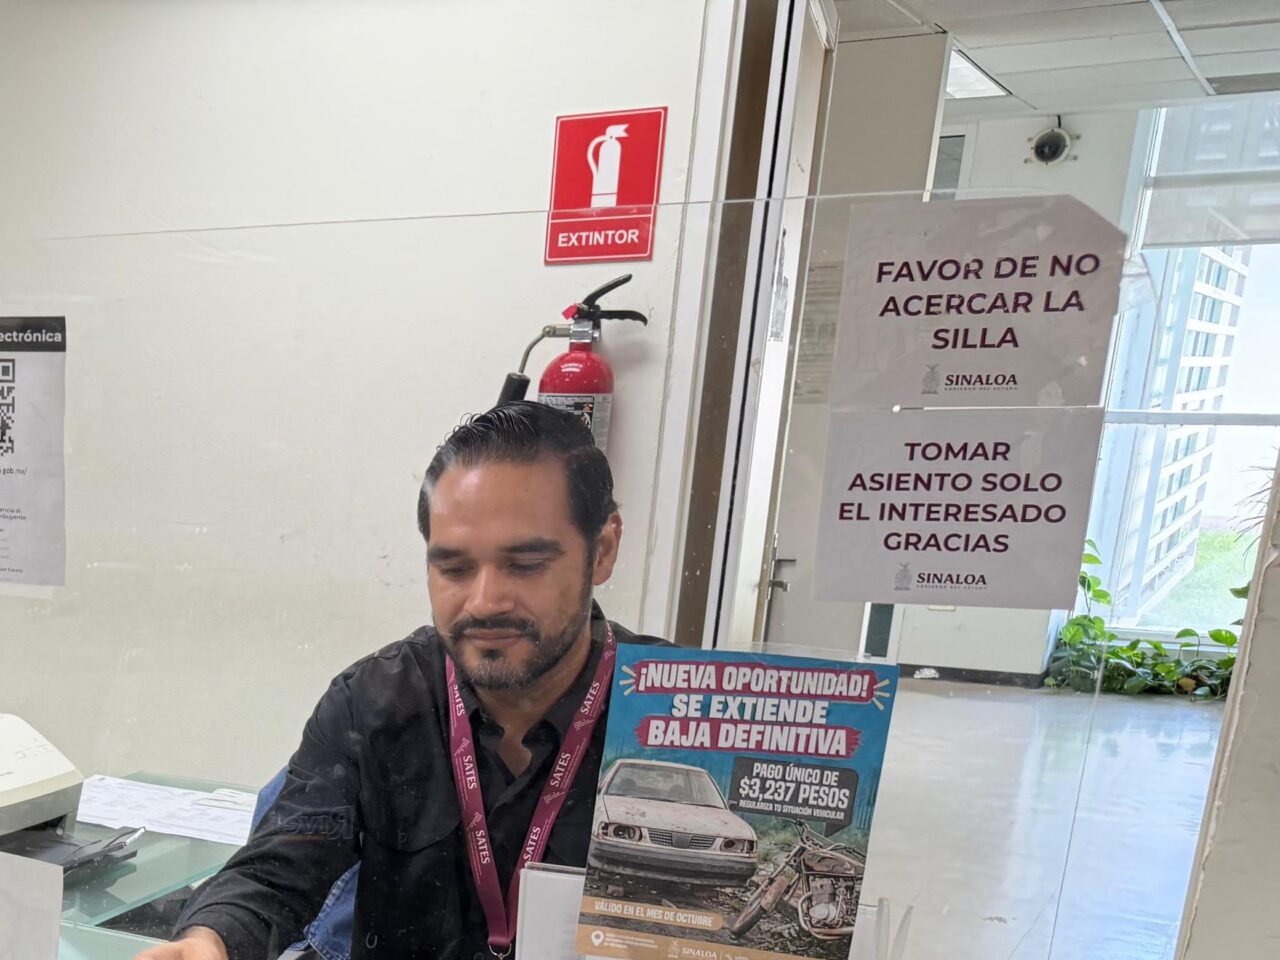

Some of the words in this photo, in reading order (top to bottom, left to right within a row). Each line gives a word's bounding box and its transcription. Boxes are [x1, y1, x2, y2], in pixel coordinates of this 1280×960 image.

[557, 229, 639, 248] EXTINTOR
[876, 257, 984, 283] FAVOR
[993, 255, 1039, 279] DE
[1049, 253, 1101, 277] NO
[878, 290, 1033, 317] ACERCAR
[1043, 289, 1085, 313] LA
[931, 327, 1019, 350] SILLA
[944, 374, 1018, 386] SINALOA
[904, 442, 1011, 462] TOMAR
[848, 472, 972, 492] ASIENTO
[981, 472, 1063, 493] SOLO
[838, 502, 870, 521] EL
[879, 503, 1066, 524] INTERESADO
[883, 532, 1010, 553] GRACIAS
[916, 572, 987, 585] SINALOA
[639, 662, 716, 690] ¡NUEVA
[722, 667, 870, 697] OPORTUNIDAD!
[453, 684, 465, 717] SATES
[580, 680, 601, 715] SATES
[672, 694, 703, 718] SE
[709, 697, 829, 724] EXTIENDE
[647, 719, 711, 748] BAJA
[718, 724, 847, 755] DEFINITIVA
[463, 755, 477, 790] SATES
[550, 752, 571, 788] SATES
[752, 762, 783, 780] PAGO
[785, 763, 820, 784] ÚNICO
[823, 770, 840, 786] DE
[739, 776, 796, 802] $3,237
[798, 784, 850, 809] PESOS
[475, 829, 491, 865] SATES
[523, 826, 541, 861] SATES
[594, 901, 623, 913] VÁLIDO
[624, 905, 634, 916] EN
[635, 907, 644, 917] EL
[646, 908, 663, 920] MES
[663, 911, 675, 921] DE
[676, 912, 713, 927] OCTUBRE
[681, 947, 718, 959] SINALOA
